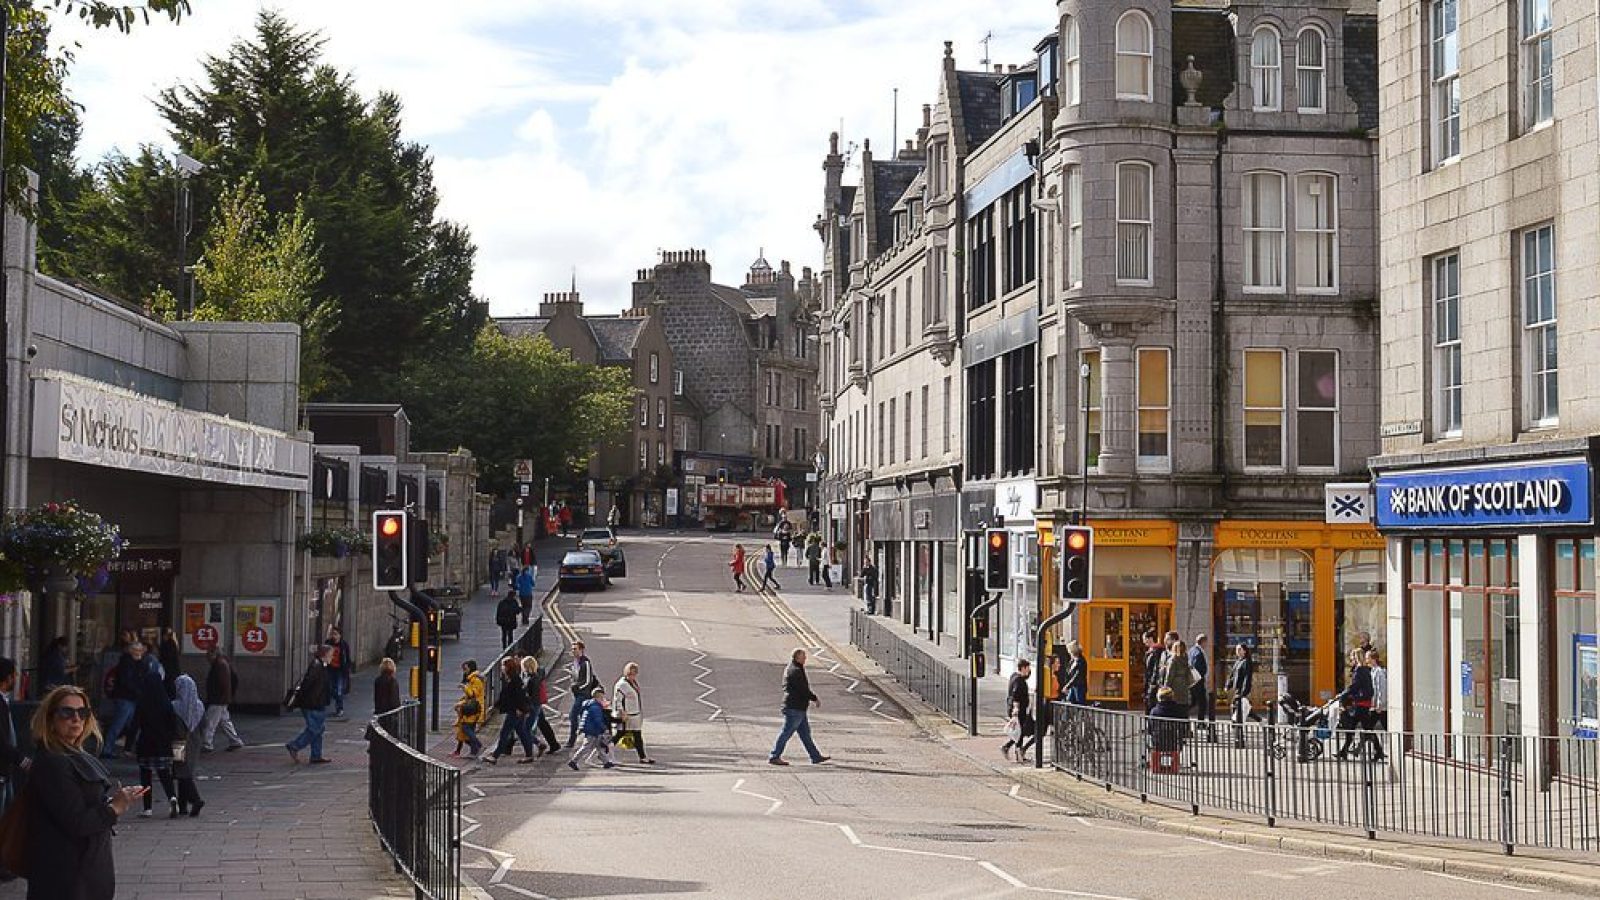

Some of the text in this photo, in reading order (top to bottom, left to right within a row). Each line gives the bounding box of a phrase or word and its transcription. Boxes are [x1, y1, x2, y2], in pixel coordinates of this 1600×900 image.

[61, 403, 139, 454] St Nicholas
[1407, 479, 1562, 513] BANK OF SCOTLAND
[1240, 528, 1299, 539] L'OCCITANE
[197, 628, 214, 641] £1
[247, 629, 264, 643] £1
